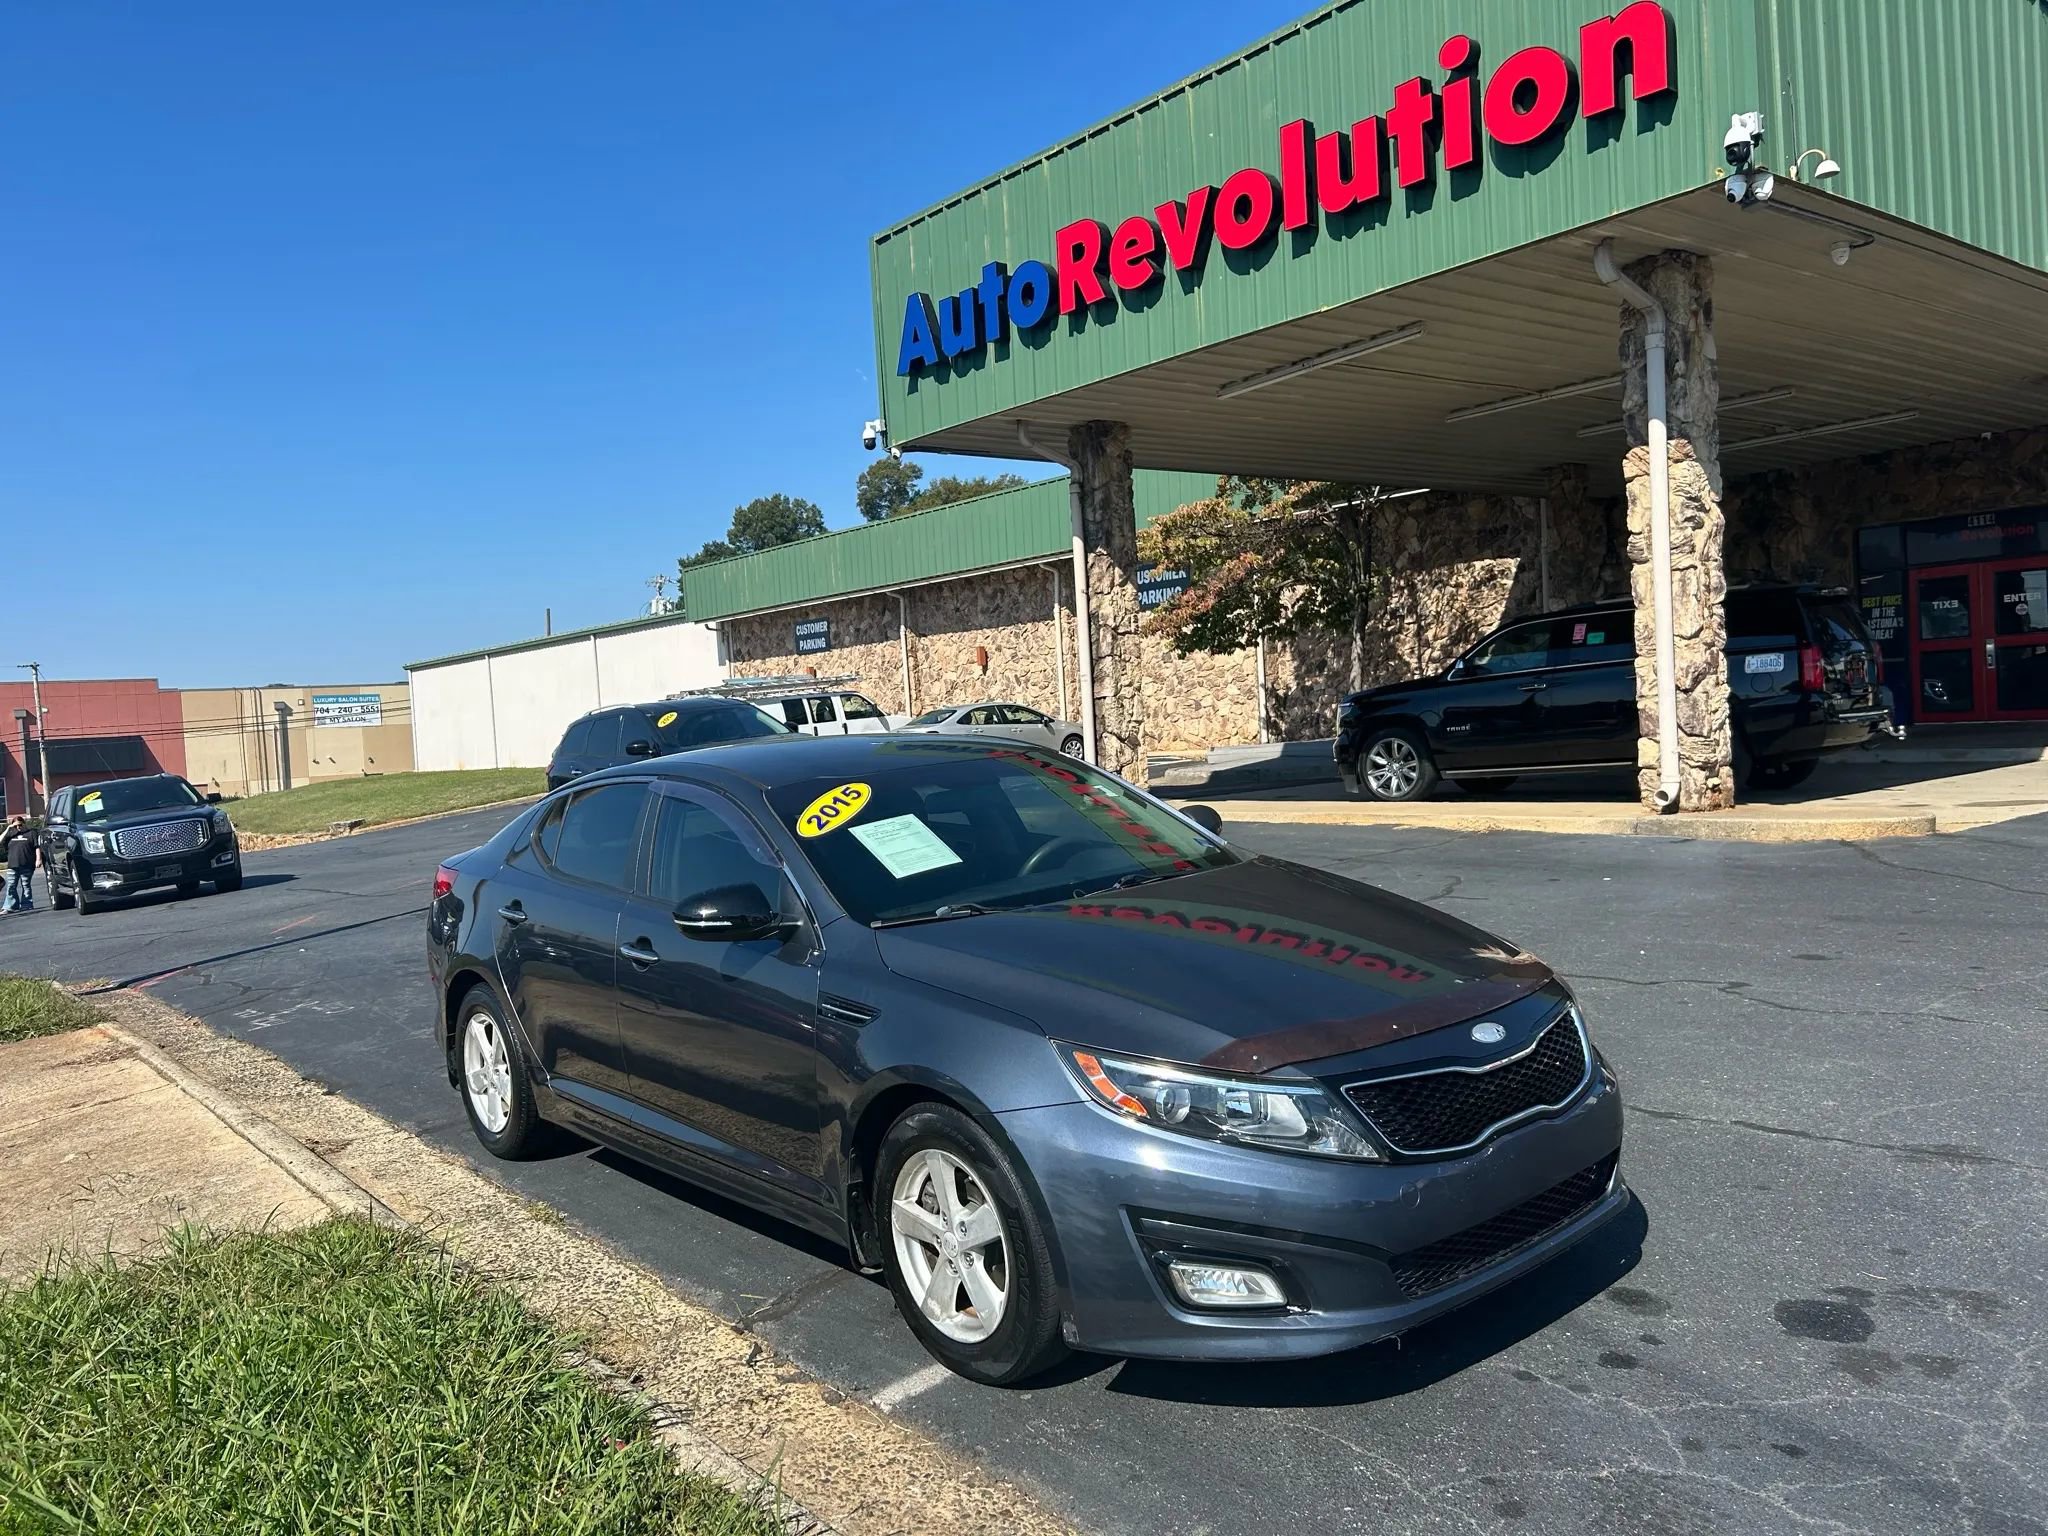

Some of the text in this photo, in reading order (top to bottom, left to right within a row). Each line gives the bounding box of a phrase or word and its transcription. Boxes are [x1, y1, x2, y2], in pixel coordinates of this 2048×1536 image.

[896, 0, 1672, 377] AutoRevolution
[1136, 569, 1187, 585] USOMER
[1862, 594, 1903, 609] BEST PRICE
[2003, 592, 2041, 603] ENTER
[1871, 606, 1896, 618] IN THE
[796, 621, 828, 635] CUSTOMER
[800, 637, 826, 651] PARKING
[806, 786, 862, 831] 2015
